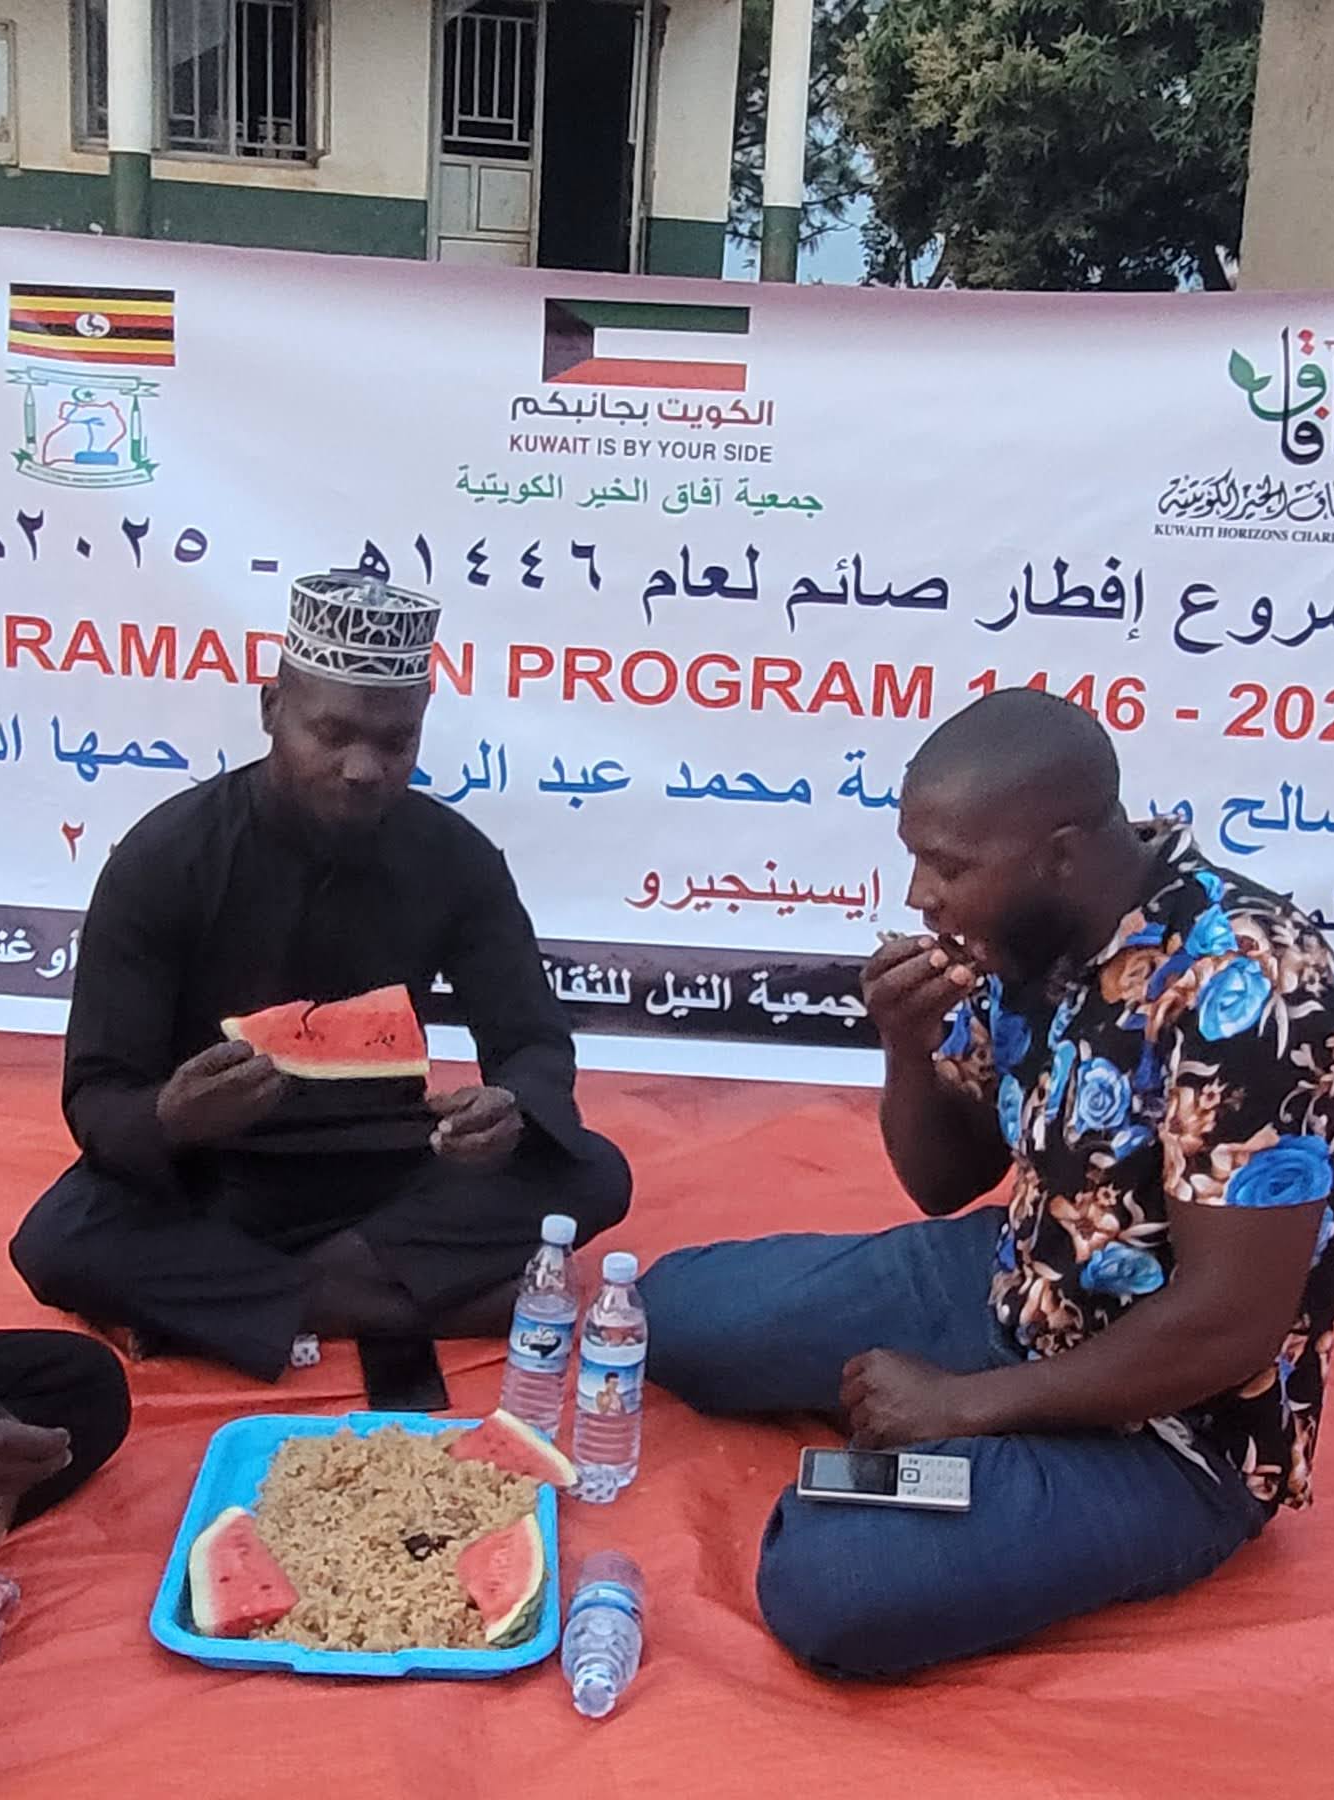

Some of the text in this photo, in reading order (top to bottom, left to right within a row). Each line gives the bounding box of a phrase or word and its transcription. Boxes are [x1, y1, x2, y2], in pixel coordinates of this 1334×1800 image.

[511, 391, 774, 430] الكويت بجانبكم
[509, 433, 773, 464] KUWAIT IS BY YOUR SIDE
[455, 465, 824, 519] جمعية آفاق الخير الكويتية
[1154, 523, 1215, 539] KUWAITI
[1217, 526, 1288, 542] HORIZONS
[642, 543, 761, 626] لعام
[786, 552, 949, 633] صائم
[974, 555, 1144, 641] إفطار
[4, 614, 475, 697] RAMADN
[507, 644, 935, 720] PROGRAM
[538, 755, 632, 810] عبد
[665, 761, 812, 806] محمد
[623, 860, 881, 923] إيسينجيرو
[645, 970, 732, 1018] النيل
[748, 970, 868, 1028] جمعية
